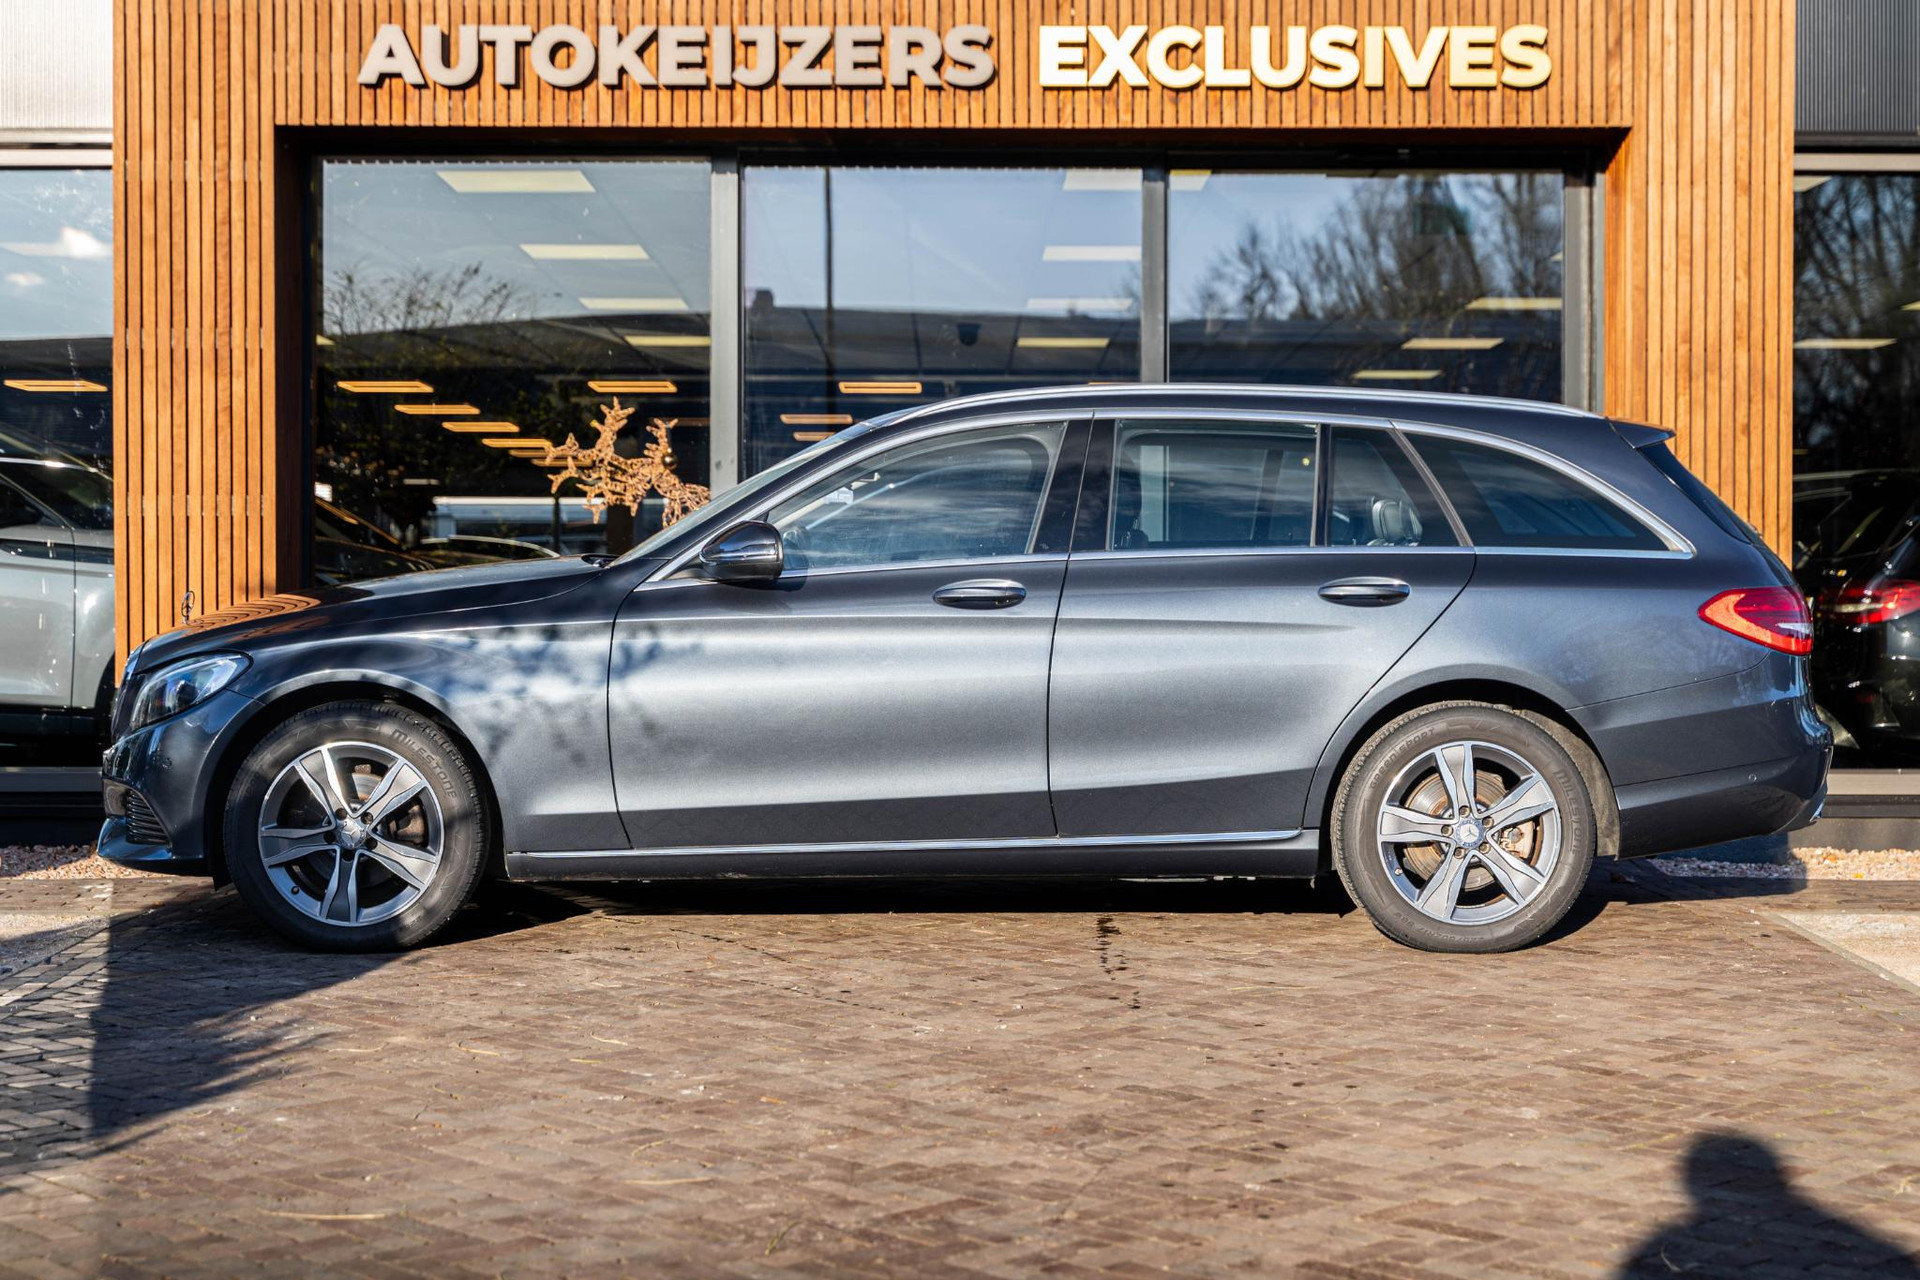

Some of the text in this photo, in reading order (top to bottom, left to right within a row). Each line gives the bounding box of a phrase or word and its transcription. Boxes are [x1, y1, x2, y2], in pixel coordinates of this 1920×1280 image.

[358, 24, 1553, 88] AUTOKEIJZERS EXCLUSIVES
[391, 728, 457, 798] MILESTONE
[1398, 727, 1436, 753] SPORT
